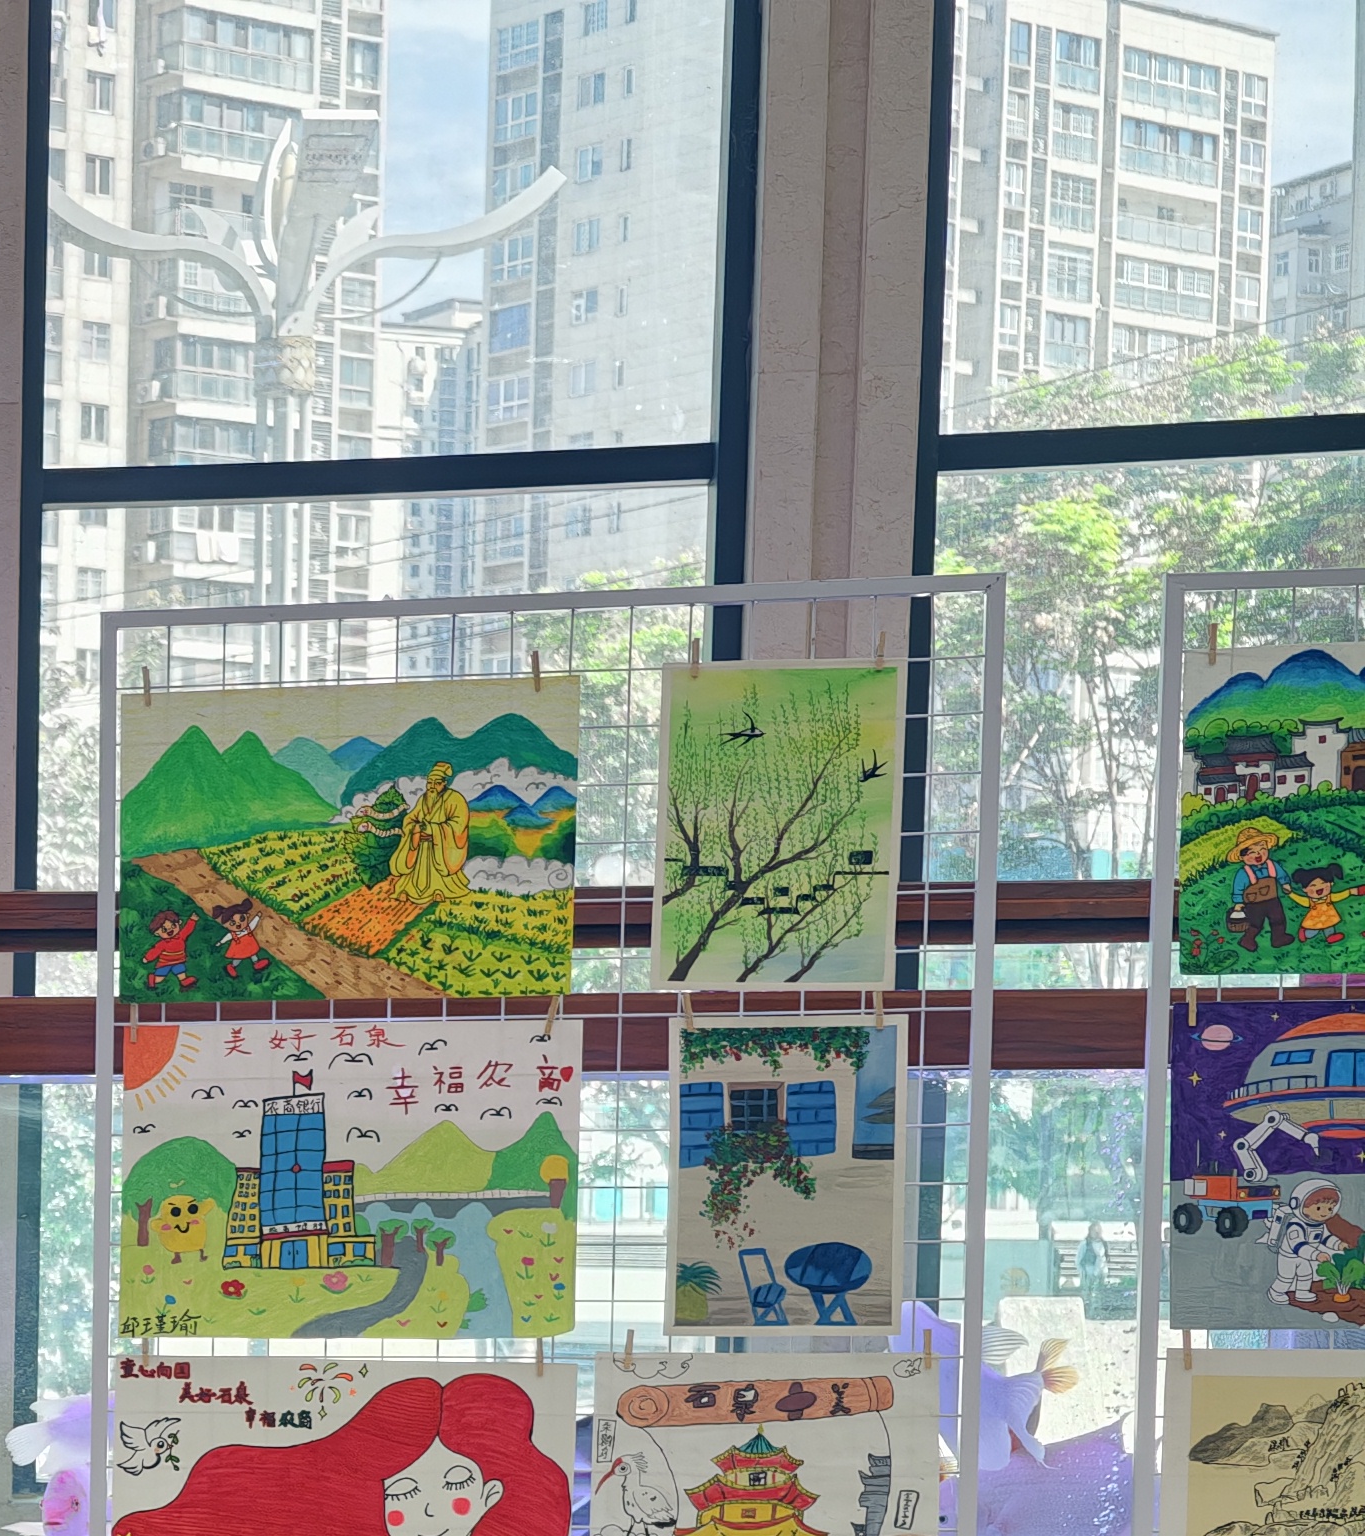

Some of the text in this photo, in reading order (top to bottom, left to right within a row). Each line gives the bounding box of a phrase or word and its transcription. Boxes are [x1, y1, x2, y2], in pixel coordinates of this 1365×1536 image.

[223, 1025, 406, 1057] 美好石泉
[178, 1381, 254, 1406] 美好石泉
